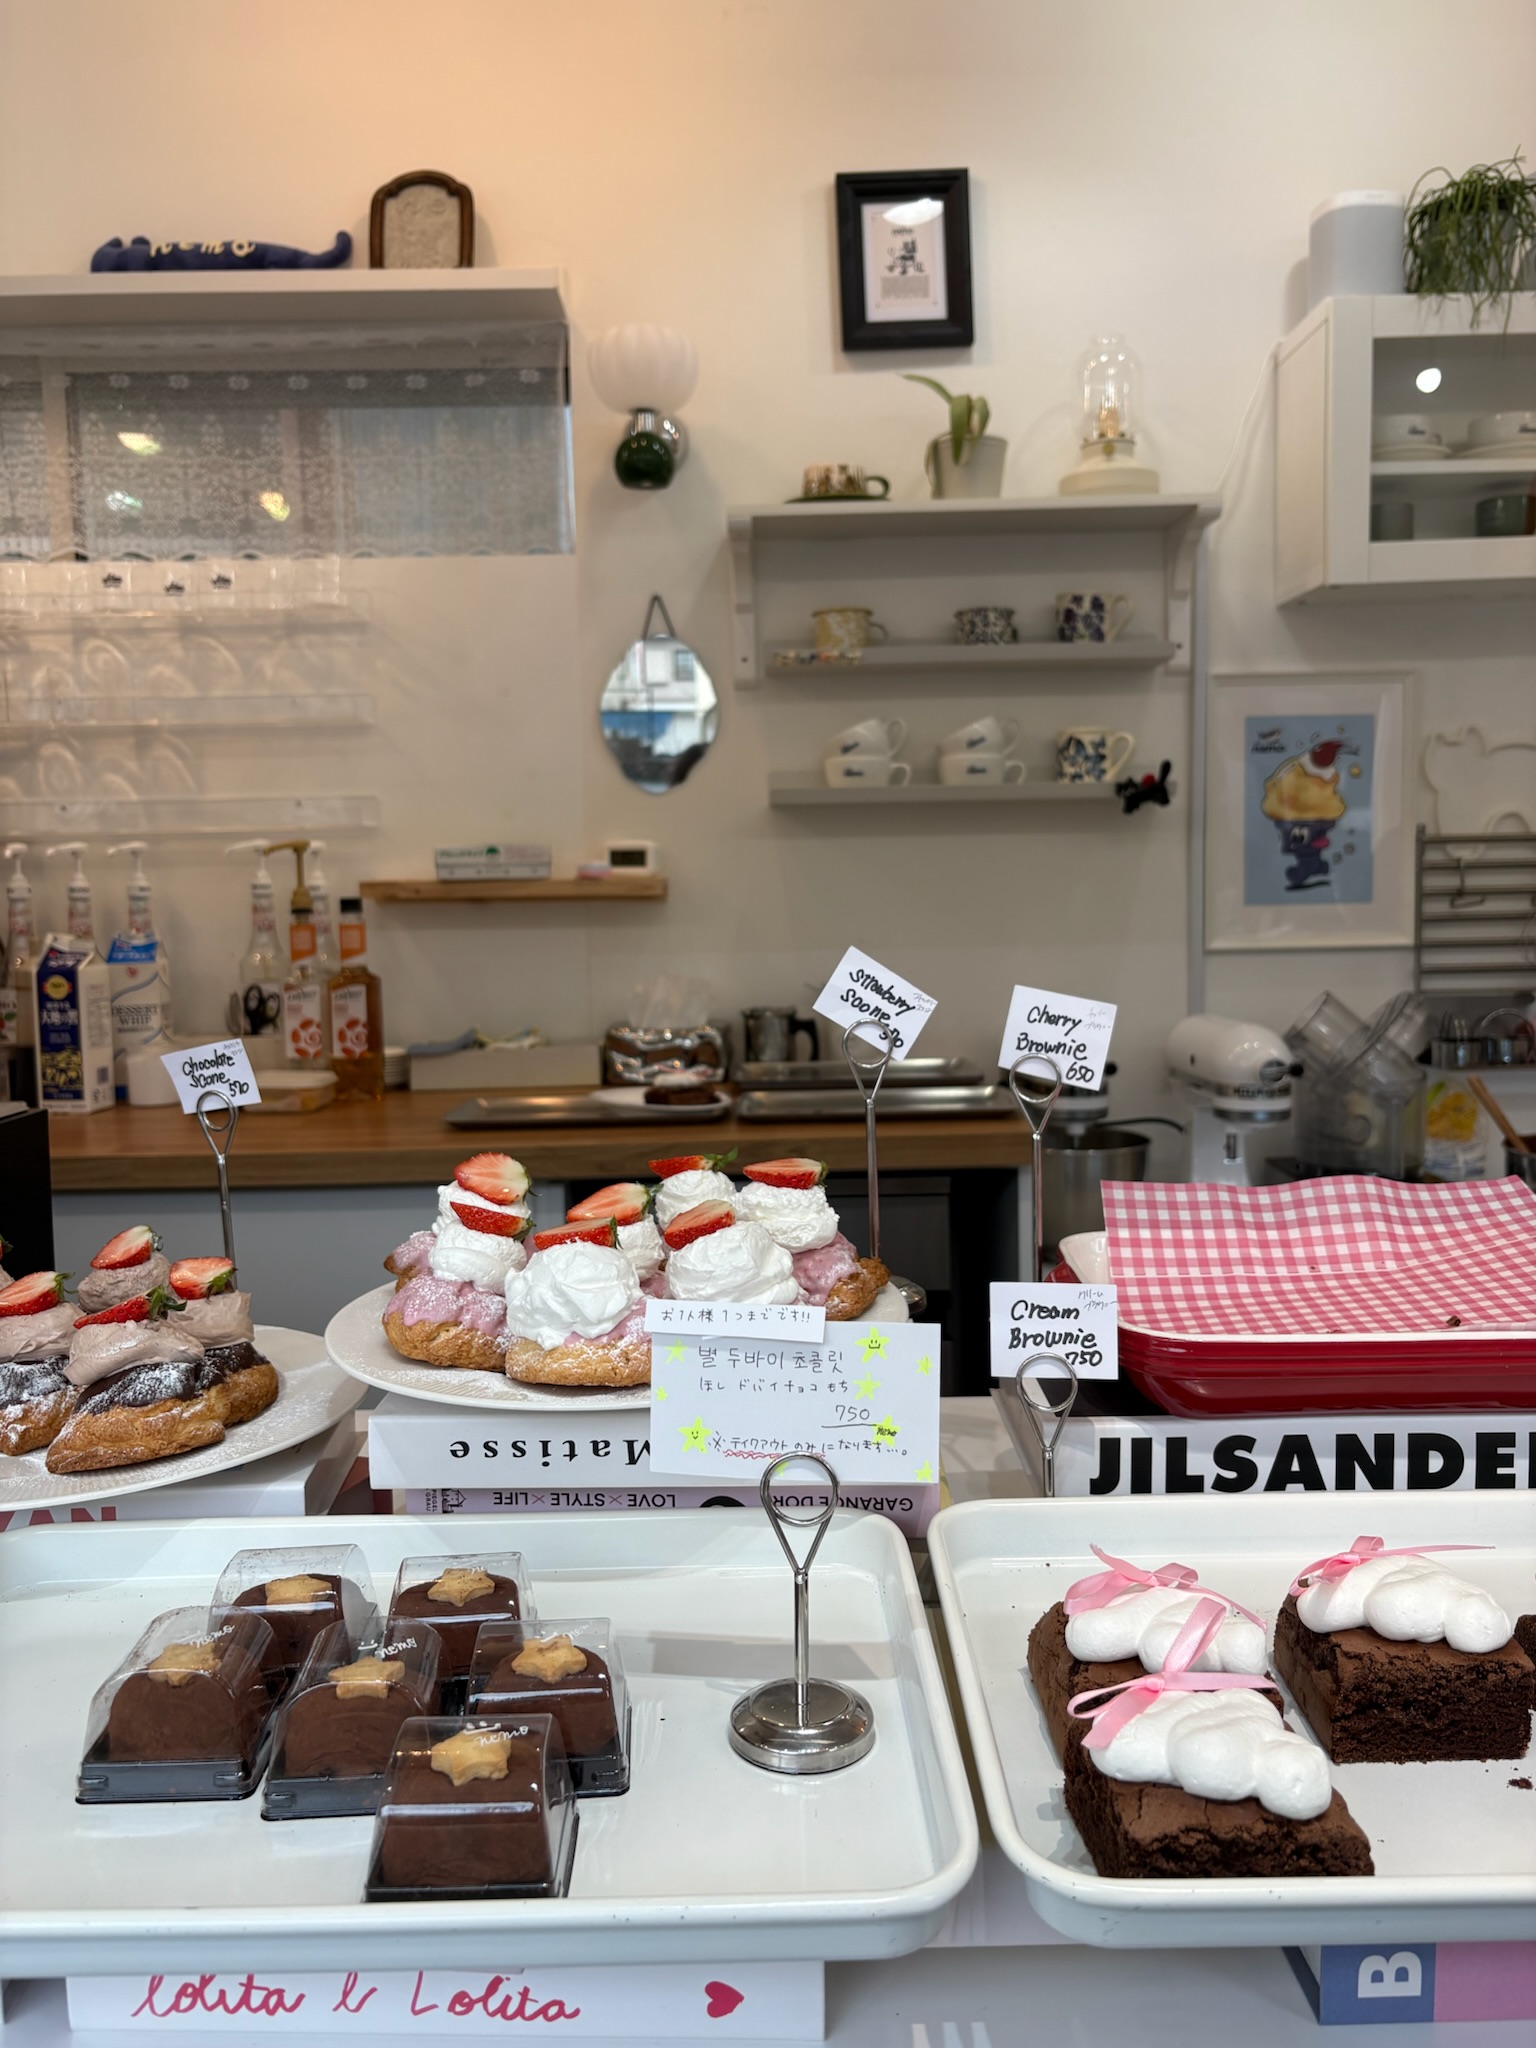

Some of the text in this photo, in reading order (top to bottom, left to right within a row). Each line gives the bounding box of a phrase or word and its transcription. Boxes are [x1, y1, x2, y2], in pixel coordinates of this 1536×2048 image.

[1027, 1004, 1082, 1036] Cherry
[1015, 1032, 1088, 1061] Brownie
[182, 1048, 235, 1076] Chocolate
[1065, 1061, 1094, 1083] 650
[190, 1072, 231, 1089] Scone
[229, 1081, 249, 1097] 570
[1011, 1299, 1080, 1321] Cream
[1008, 1327, 1097, 1350] Brownie
[698, 1346, 843, 1374] 별 두바이 초콜릿
[1065, 1350, 1103, 1367] 750
[835, 1404, 870, 1422] 750
[1089, 1432, 1536, 1495] JILSANDE
